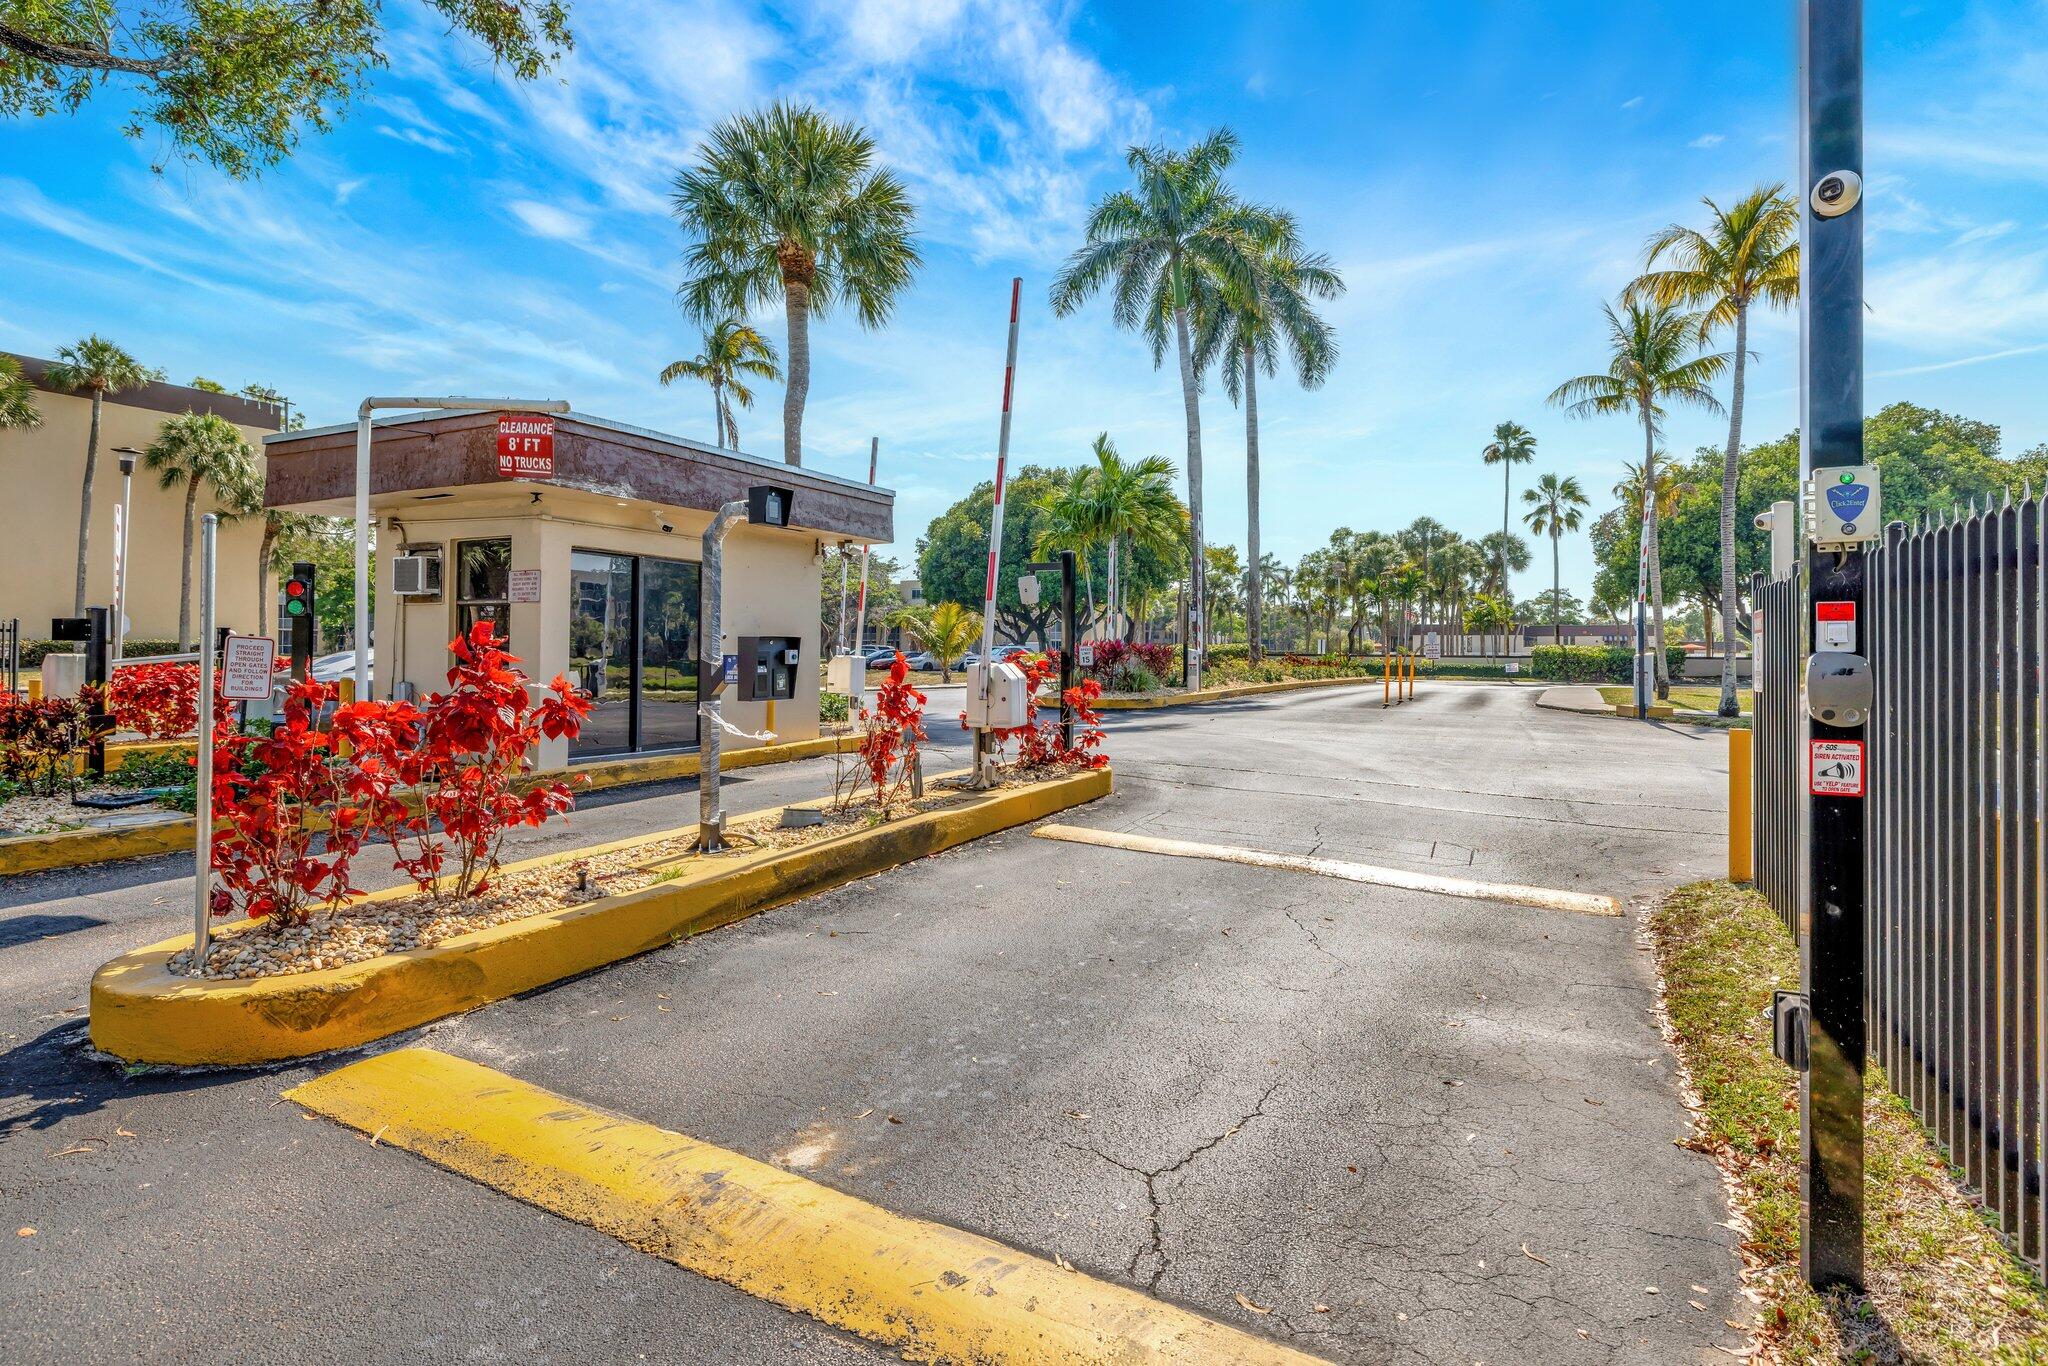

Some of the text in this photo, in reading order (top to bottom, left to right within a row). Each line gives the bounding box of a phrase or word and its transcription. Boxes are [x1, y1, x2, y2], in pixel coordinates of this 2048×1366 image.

[500, 421, 553, 435] CLEARANCE
[508, 437, 541, 452] 8' FT
[499, 455, 552, 470] NO TRUCKS
[1082, 655, 1091, 664] 15
